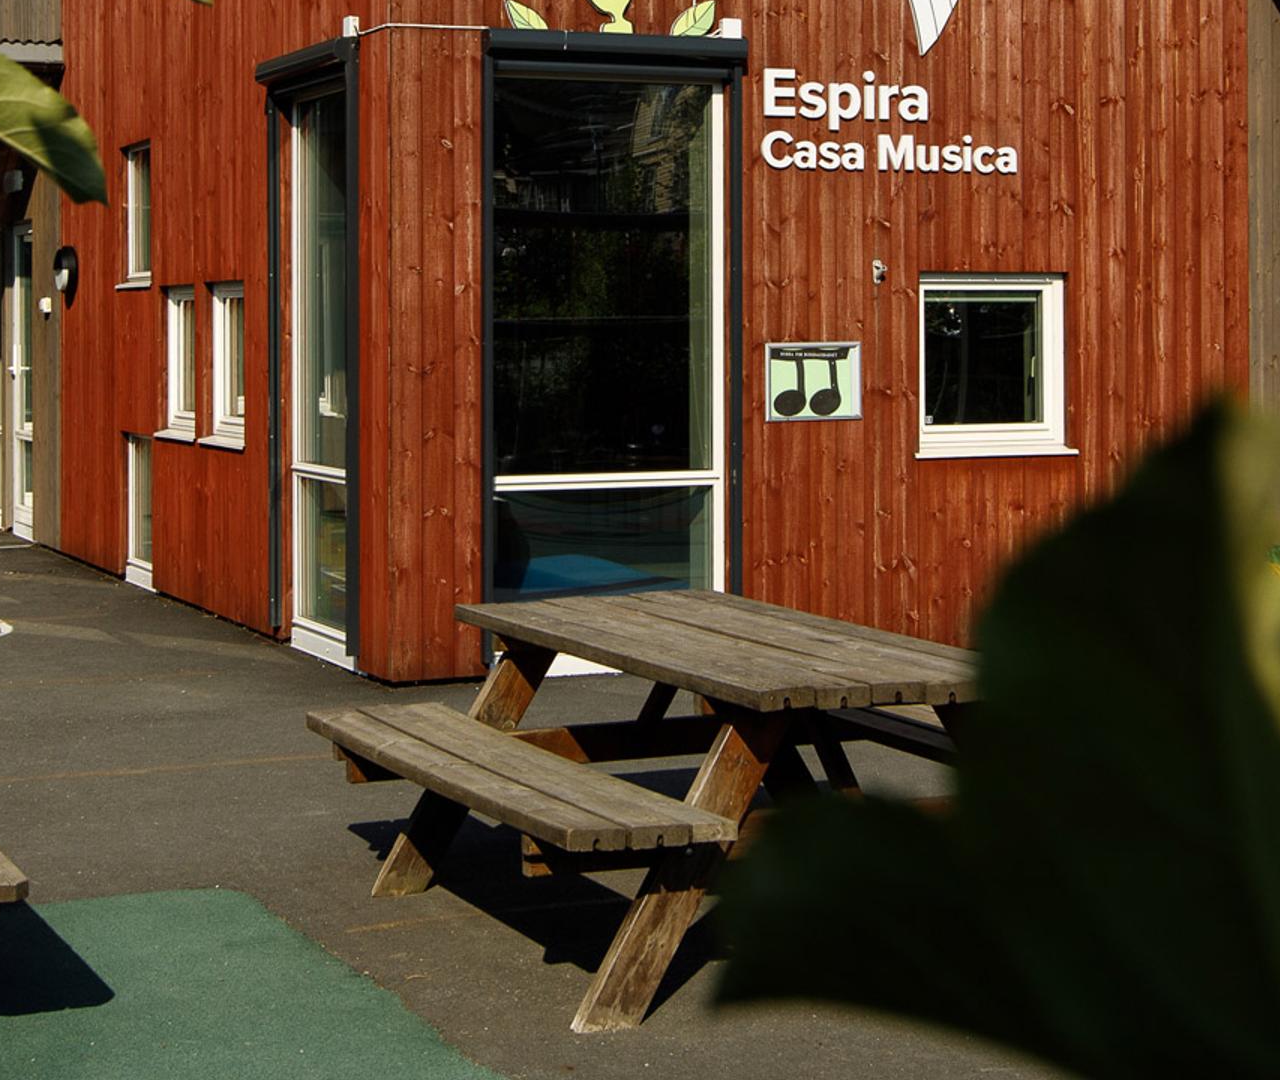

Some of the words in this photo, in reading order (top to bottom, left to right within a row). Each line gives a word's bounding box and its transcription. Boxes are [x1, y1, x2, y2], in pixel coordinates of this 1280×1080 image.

[763, 68, 929, 131] Espira
[761, 130, 865, 171] Casa
[877, 134, 1018, 174] Musica
